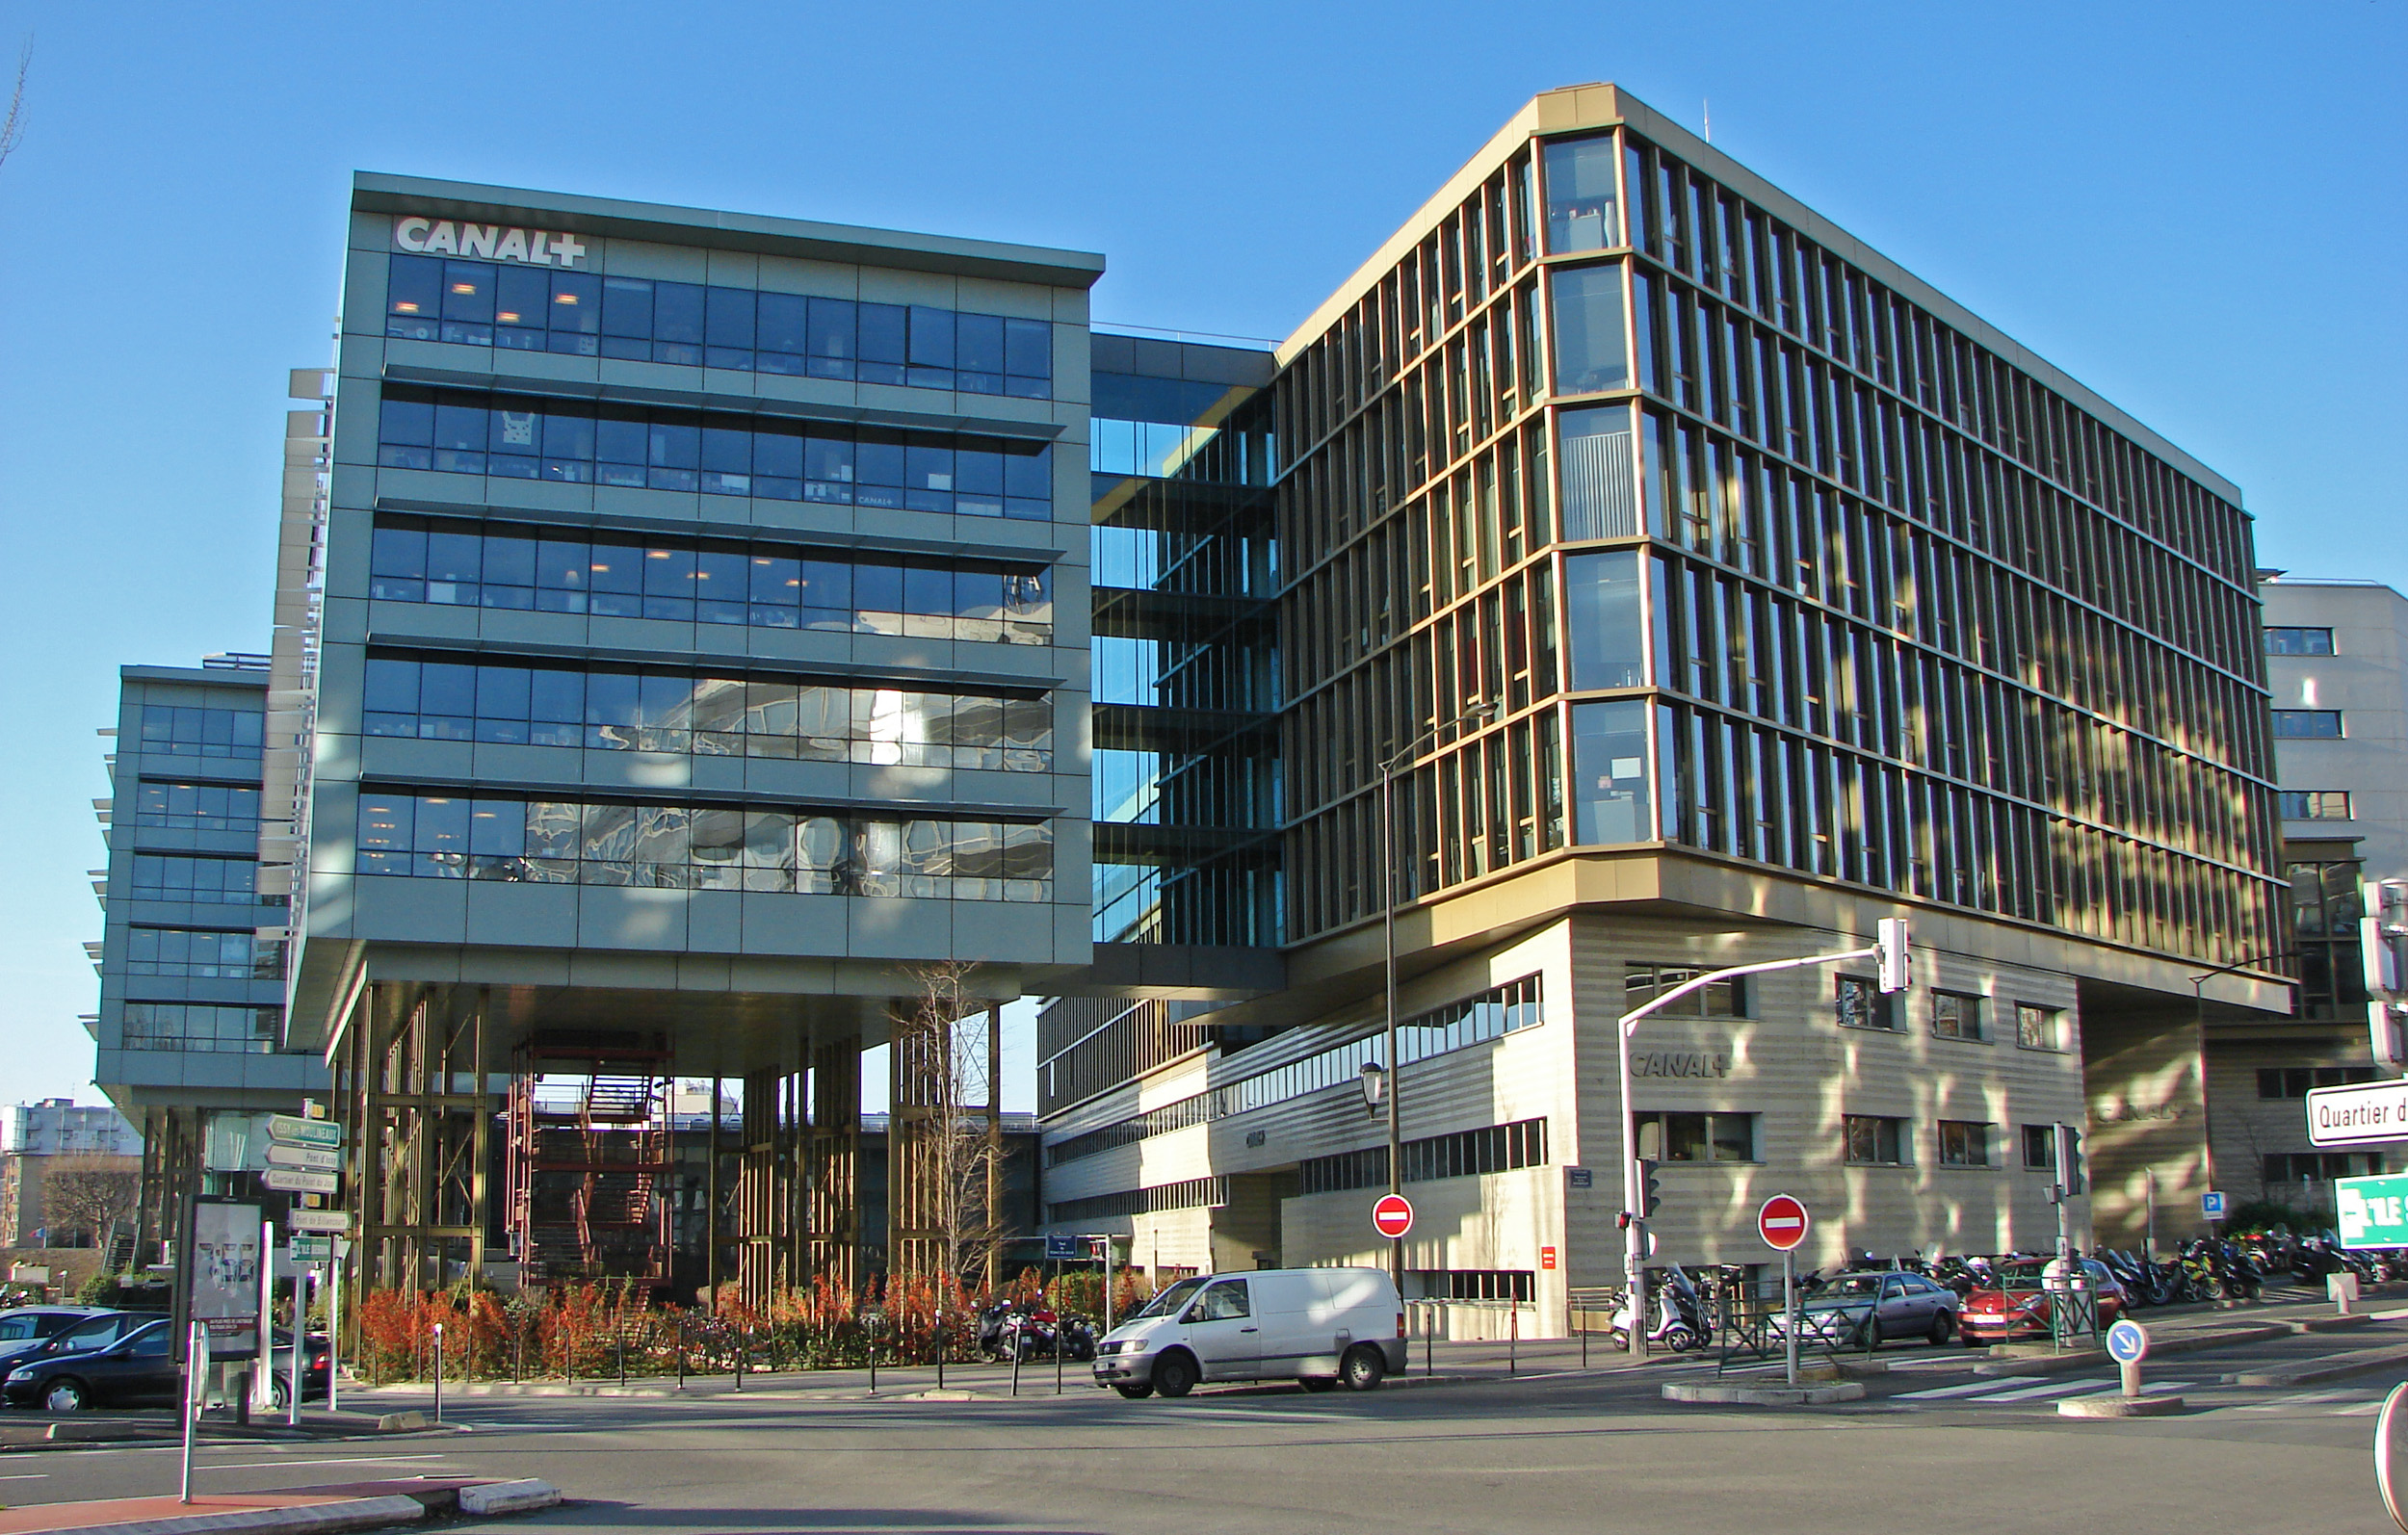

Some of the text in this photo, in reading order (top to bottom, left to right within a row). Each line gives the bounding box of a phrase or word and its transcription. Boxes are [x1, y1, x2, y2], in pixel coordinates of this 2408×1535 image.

[397, 217, 586, 267] CANAL+
[858, 496, 893, 506] CANAL+
[1629, 1052, 1732, 1078] CANAL+
[2319, 1101, 2389, 1128] Quartier
